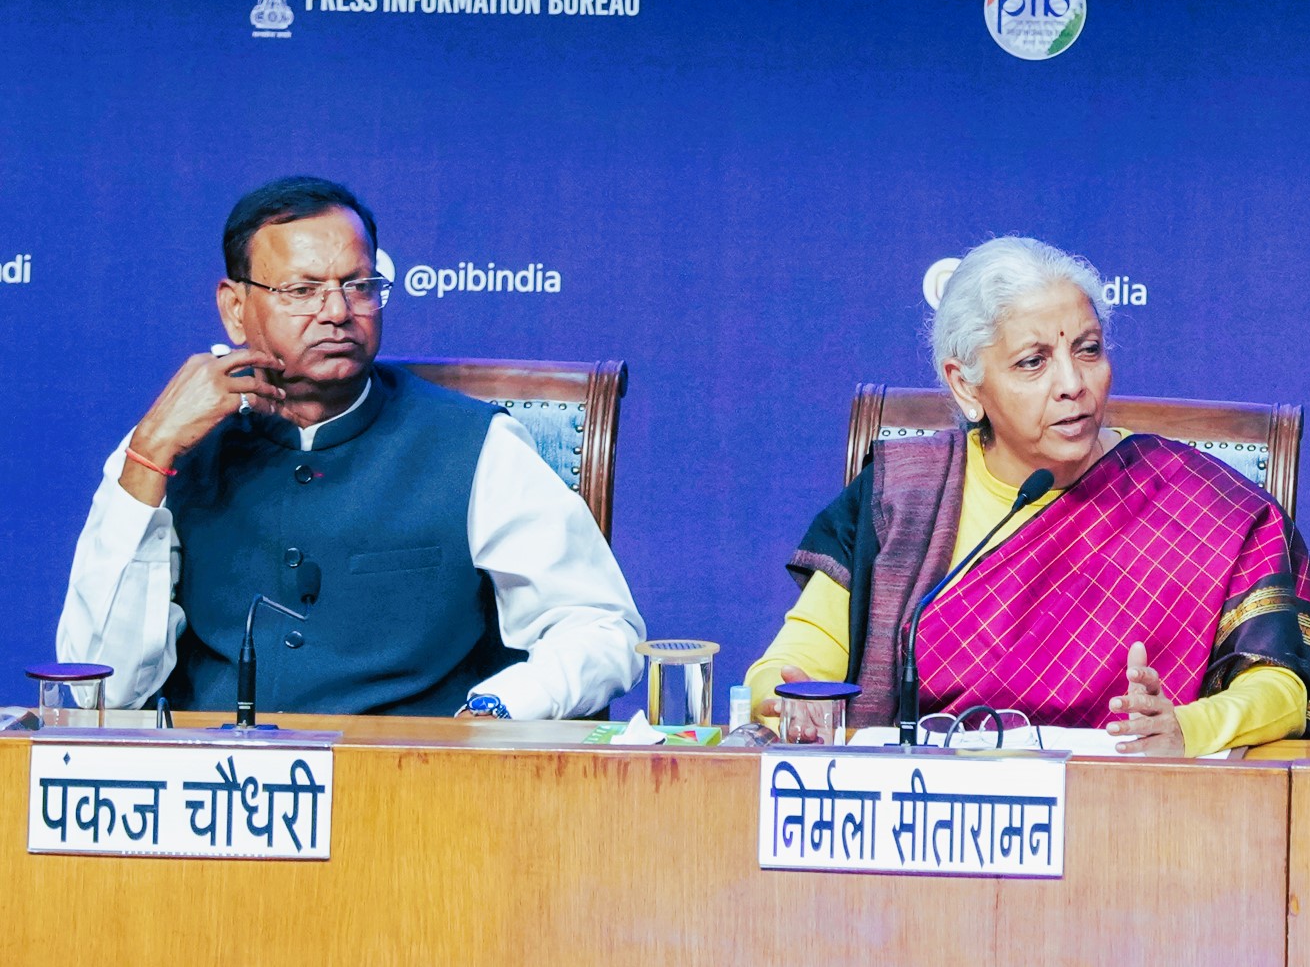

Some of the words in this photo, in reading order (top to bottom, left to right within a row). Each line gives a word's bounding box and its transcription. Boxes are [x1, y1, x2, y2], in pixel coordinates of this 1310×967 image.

[0, 254, 32, 284] di
[404, 261, 562, 299] @pibindia
[39, 751, 168, 845] पंकज
[182, 755, 326, 853] चौधरी
[770, 759, 882, 860] निर्मला
[891, 768, 1058, 868] सीतारामन
